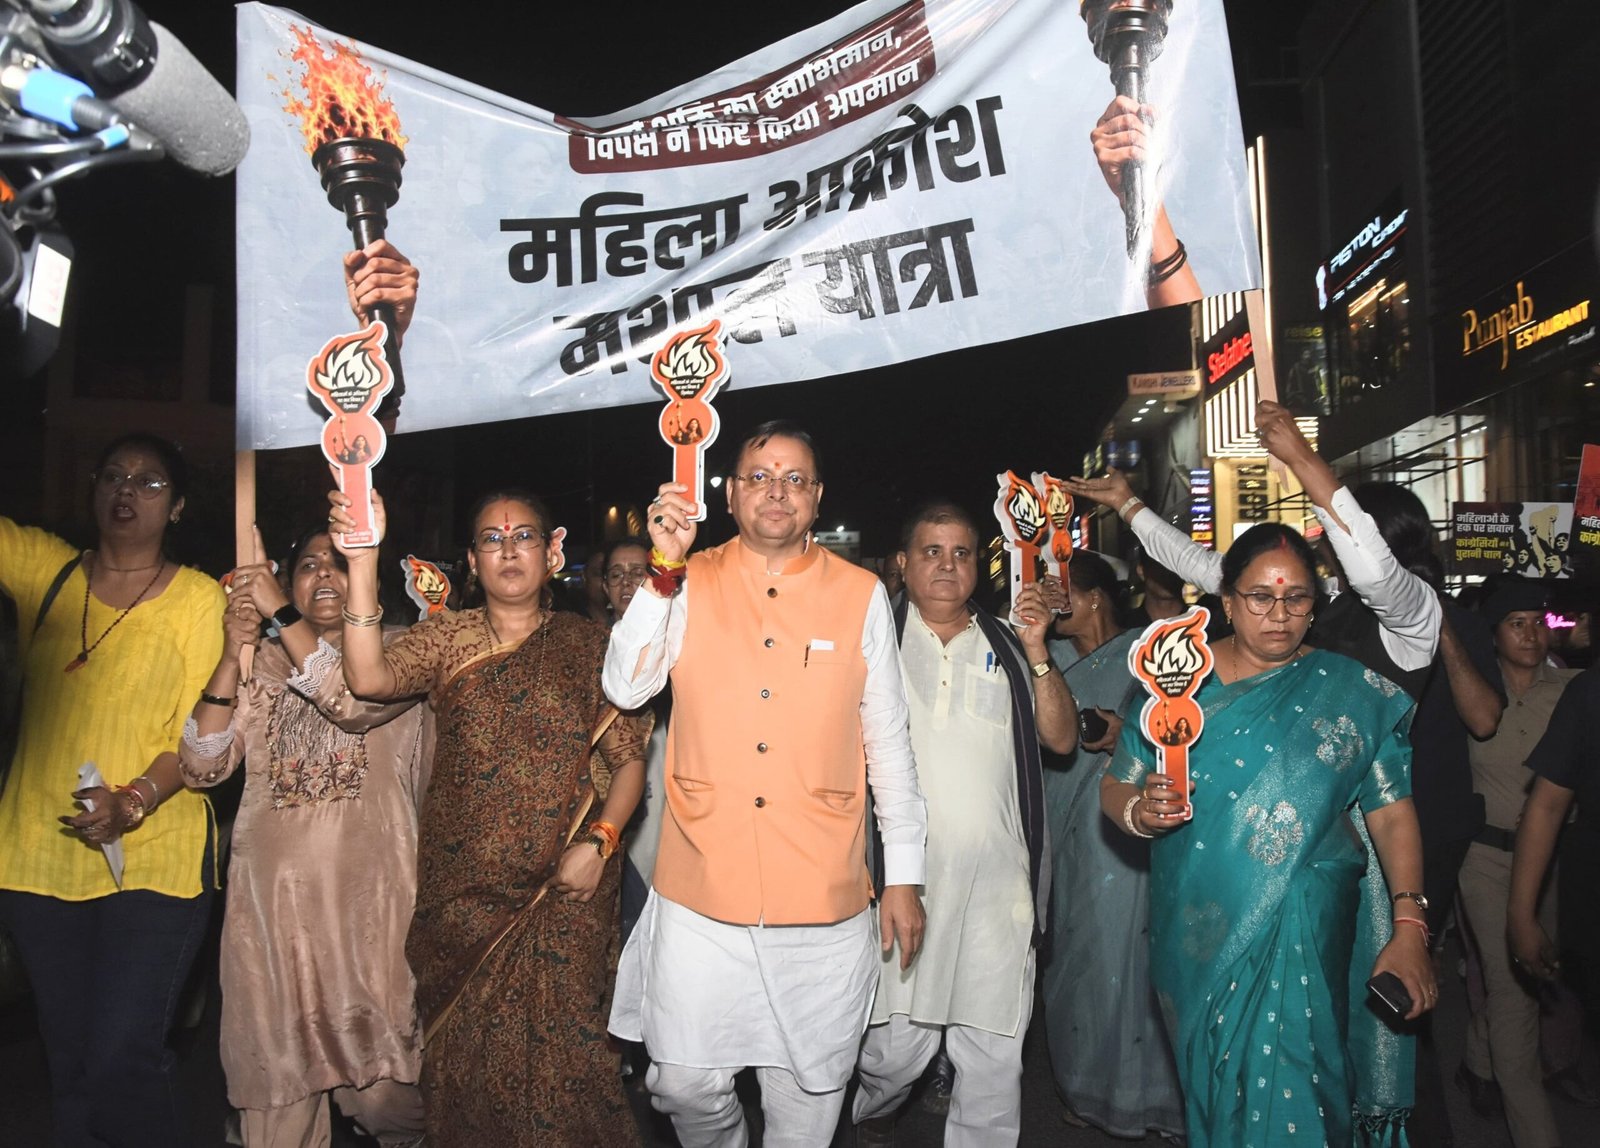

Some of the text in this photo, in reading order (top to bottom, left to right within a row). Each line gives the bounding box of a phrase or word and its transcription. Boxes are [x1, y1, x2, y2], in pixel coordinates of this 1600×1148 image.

[754, 101, 821, 144] किया
[824, 58, 922, 121] अपमान
[764, 26, 902, 110] स्वाभिमान,
[500, 95, 1006, 287] महिला आक्रोश
[801, 217, 979, 321] यात्रा
[1330, 216, 1381, 274] PISTON
[1462, 280, 1534, 370] Punjab
[1456, 548, 1502, 561] पुरानी चाल
[1473, 524, 1486, 532] पर
[1487, 524, 1515, 533] सवाल
[1500, 512, 1510, 524] के
